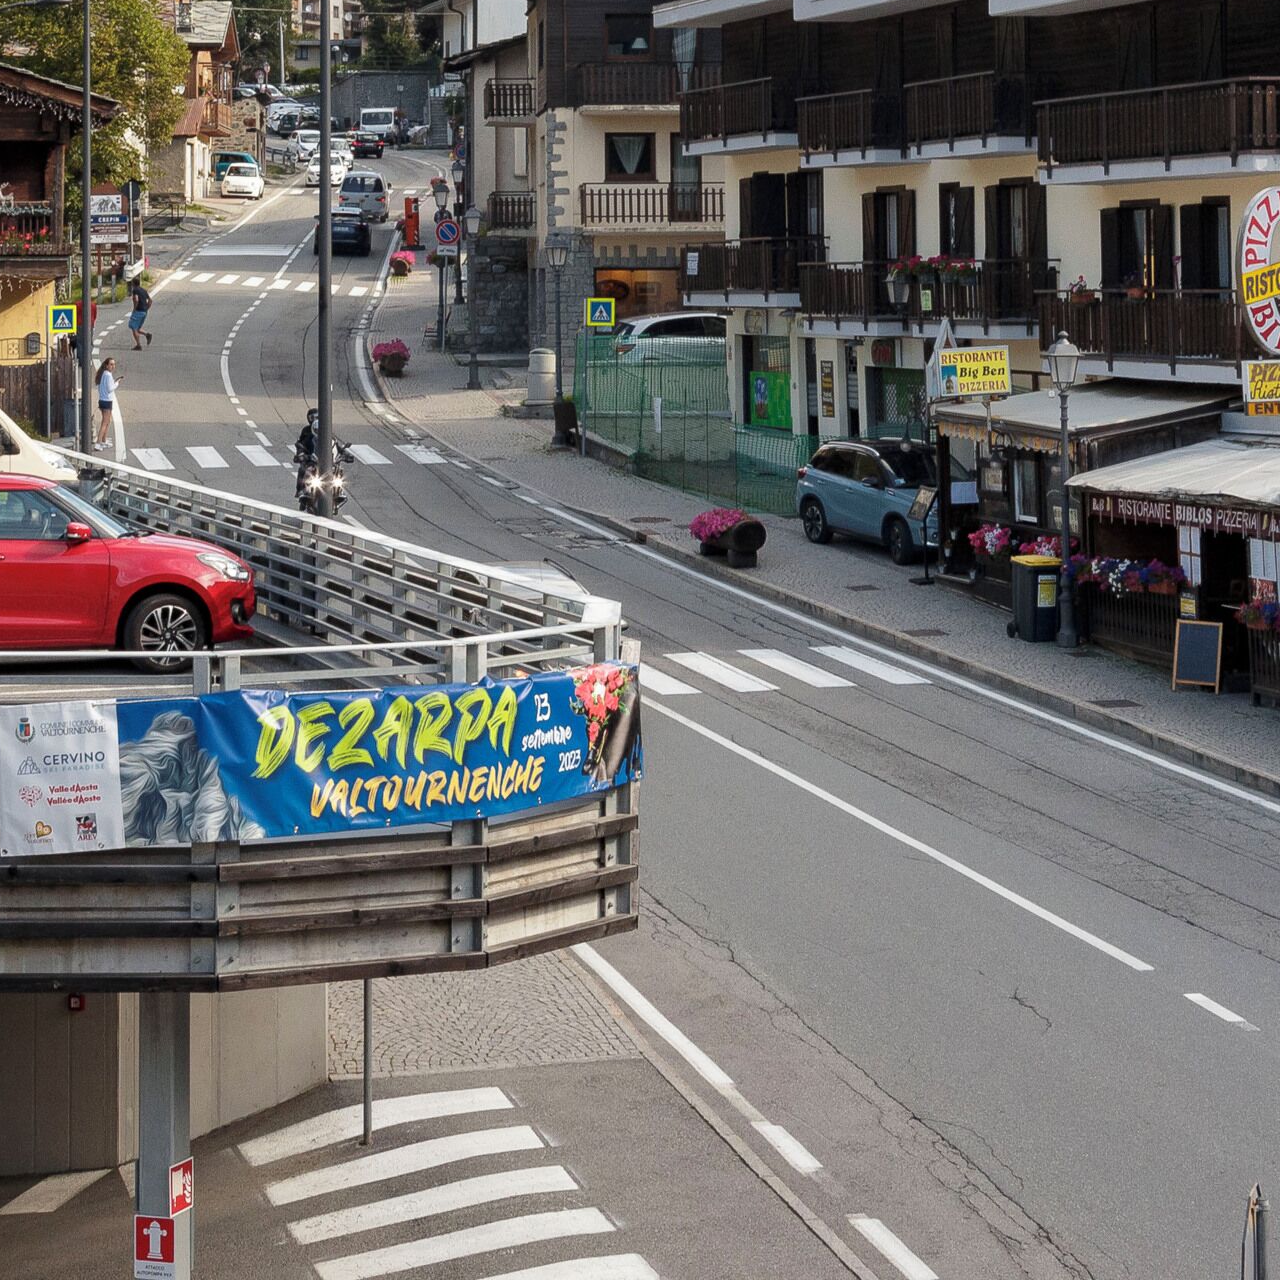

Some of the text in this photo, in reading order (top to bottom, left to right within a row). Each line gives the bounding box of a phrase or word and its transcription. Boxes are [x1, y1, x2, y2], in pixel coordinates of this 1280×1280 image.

[941, 351, 1006, 364] RISTORANTE
[960, 365, 1005, 379] Big Ben
[960, 380, 1006, 392] PIZZERIA
[1118, 498, 1171, 520] RISTORANTE
[1175, 505, 1213, 524] BIBLOS
[1216, 510, 1258, 529] PIZZERIA
[534, 693, 551, 722] 23
[40, 725, 107, 737] VALTOURNENCHE
[250, 685, 518, 780] DEZARPA
[521, 725, 572, 752] settembre
[43, 751, 105, 766] CERVINO
[558, 749, 582, 773] 2023
[62, 763, 105, 772] PARADISE
[48, 785, 69, 794] Valle
[310, 755, 546, 819] VALTOURNENCHE
[78, 833, 97, 841] AREV
